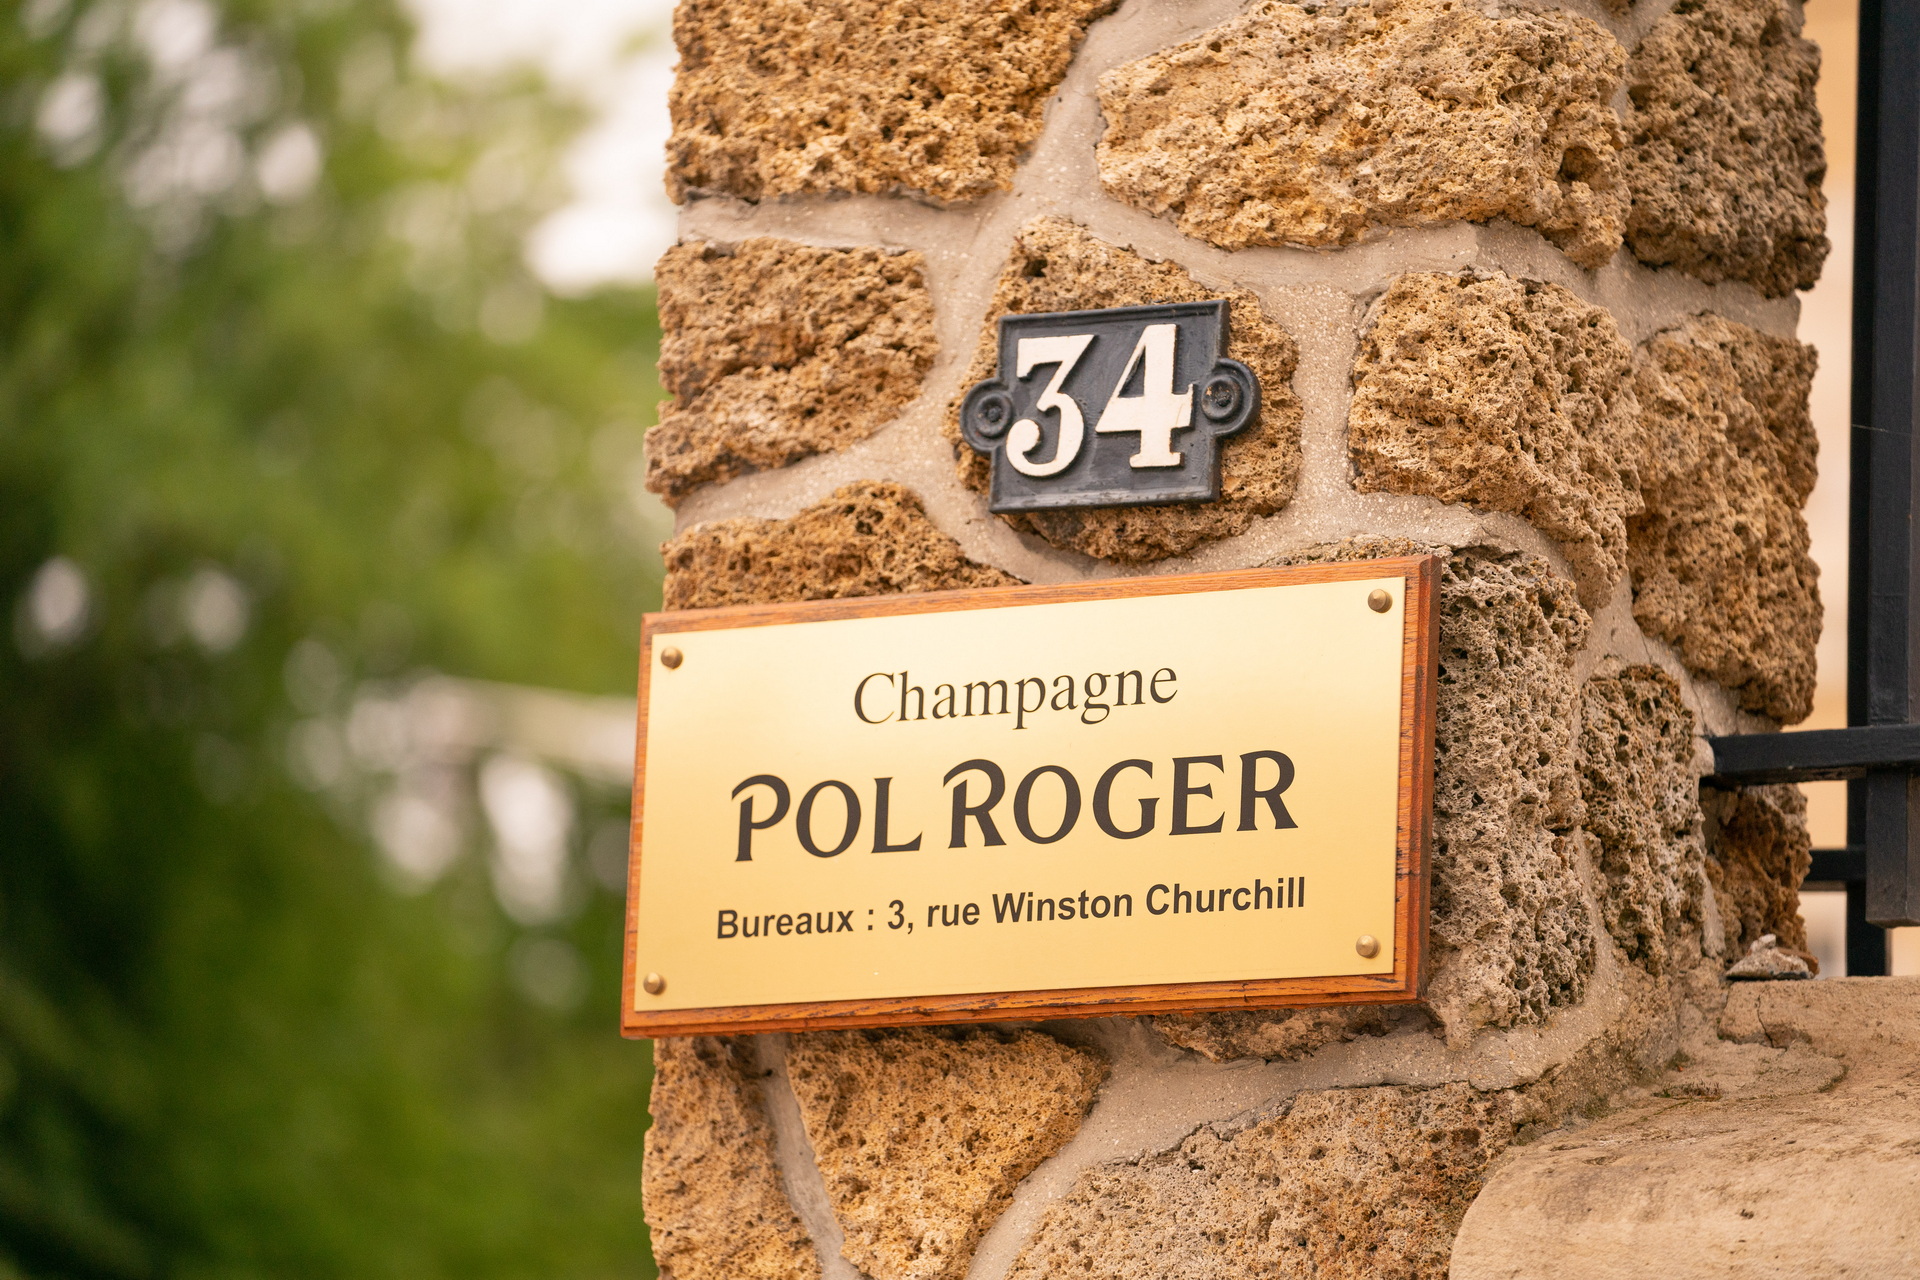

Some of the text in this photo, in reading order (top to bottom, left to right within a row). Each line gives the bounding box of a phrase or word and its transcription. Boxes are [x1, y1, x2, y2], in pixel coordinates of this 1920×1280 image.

[1005, 323, 1194, 478] 34
[853, 667, 1178, 731] Champagne
[731, 749, 1299, 863] POL ROGER
[717, 908, 854, 940] Bureaux
[887, 899, 915, 936] 3,
[926, 903, 981, 929] rue
[992, 889, 1133, 924] Winston
[1146, 876, 1306, 917] Churchill
